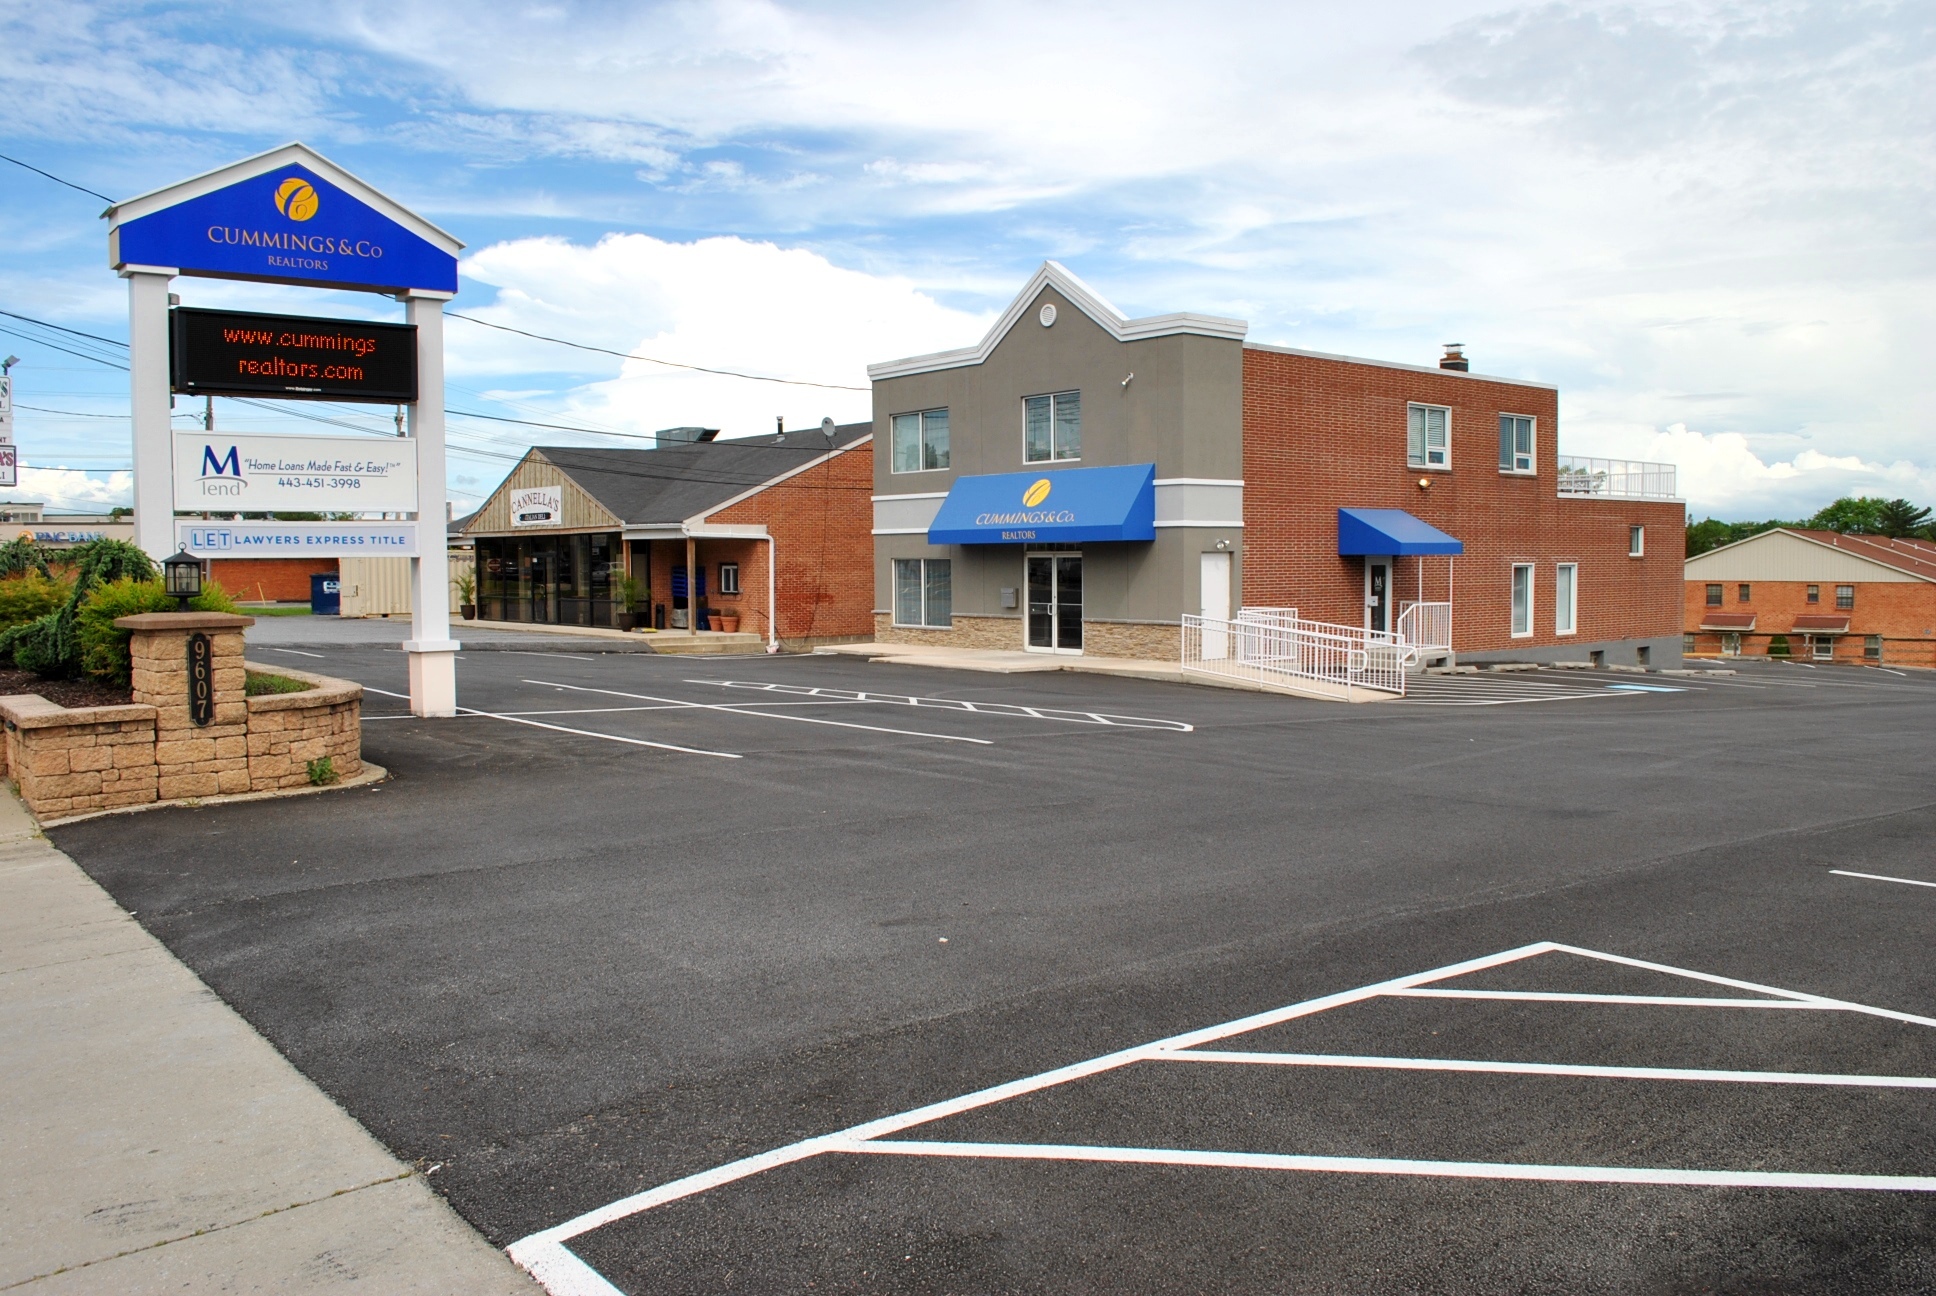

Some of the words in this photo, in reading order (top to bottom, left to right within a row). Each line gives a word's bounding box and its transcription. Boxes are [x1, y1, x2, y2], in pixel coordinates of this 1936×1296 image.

[268, 255, 329, 271] REALTORS
[224, 328, 376, 357] www.cummings
[239, 356, 364, 381] realtors.com
[201, 444, 241, 477] M
[278, 460, 304, 472] Loans
[306, 460, 332, 473] Made
[334, 461, 352, 473] Fast
[354, 461, 365, 473] &
[202, 481, 241, 497] lend
[278, 477, 361, 489] 443-451-3998
[511, 492, 560, 514] CANNELLA'S
[35, 531, 65, 542] PNC
[193, 533, 230, 546] LET
[234, 535, 300, 545] LAWYERS
[306, 535, 365, 545] EXPRESS
[370, 536, 406, 545] TITLE
[1002, 531, 1036, 540] REALTORS
[194, 641, 208, 719] 9607
